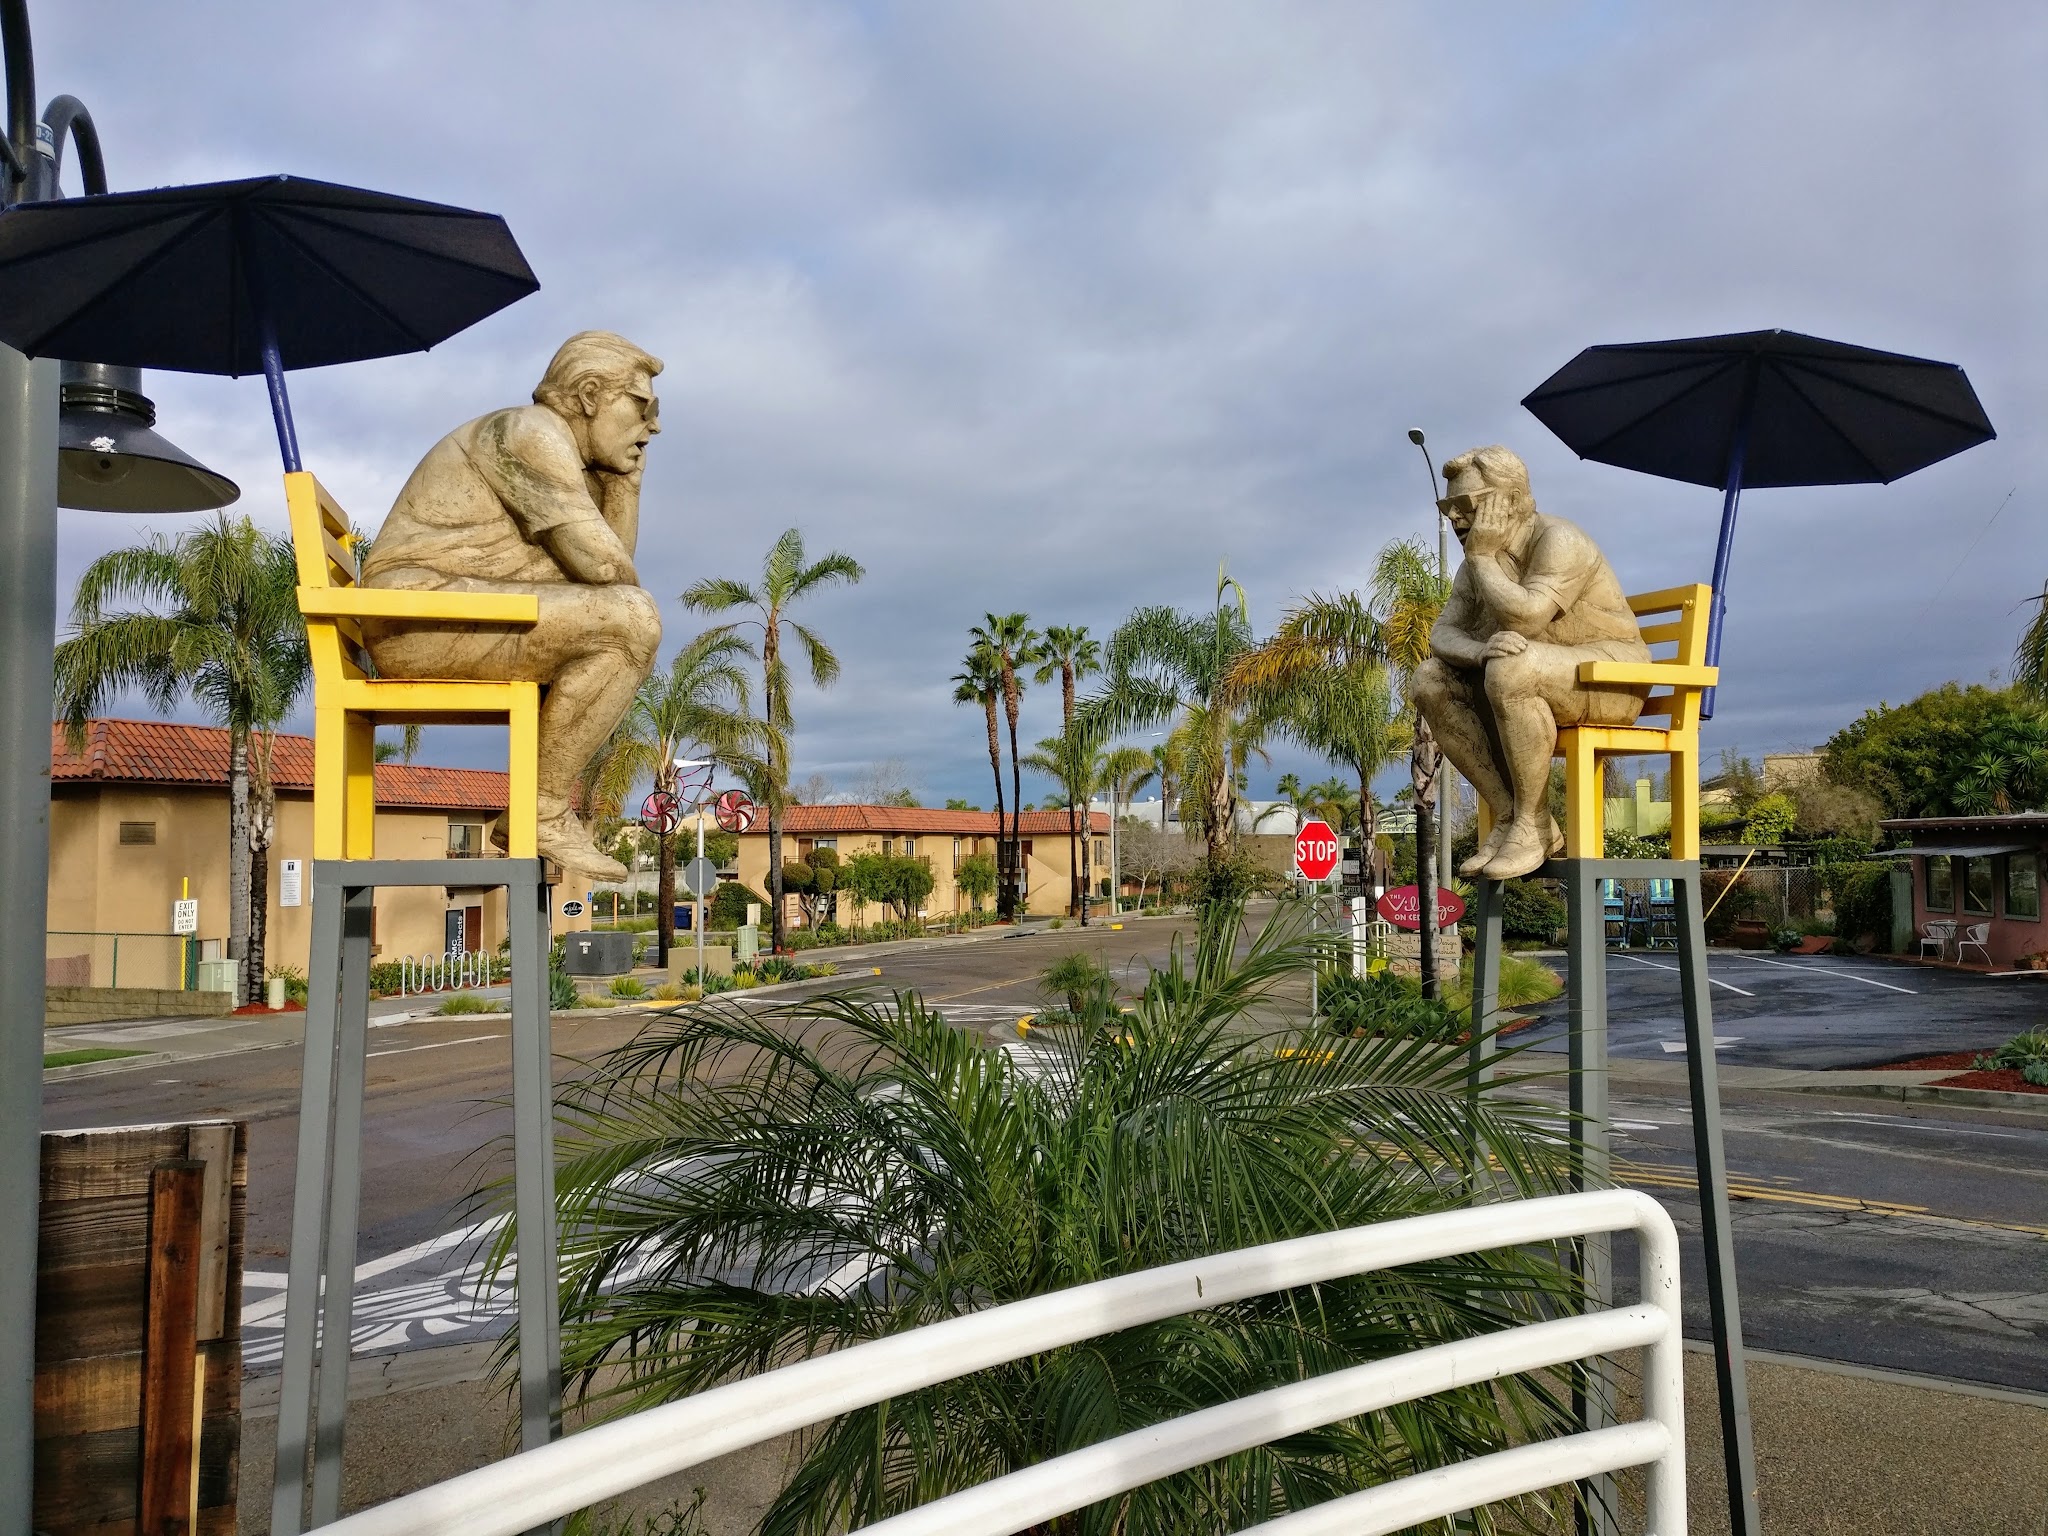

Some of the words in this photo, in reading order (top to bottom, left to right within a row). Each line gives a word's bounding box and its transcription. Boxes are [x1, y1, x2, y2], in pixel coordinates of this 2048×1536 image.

[1297, 840, 1337, 862] STOP
[1386, 896, 1458, 921] Vilge
[1394, 913, 1407, 921] ON
